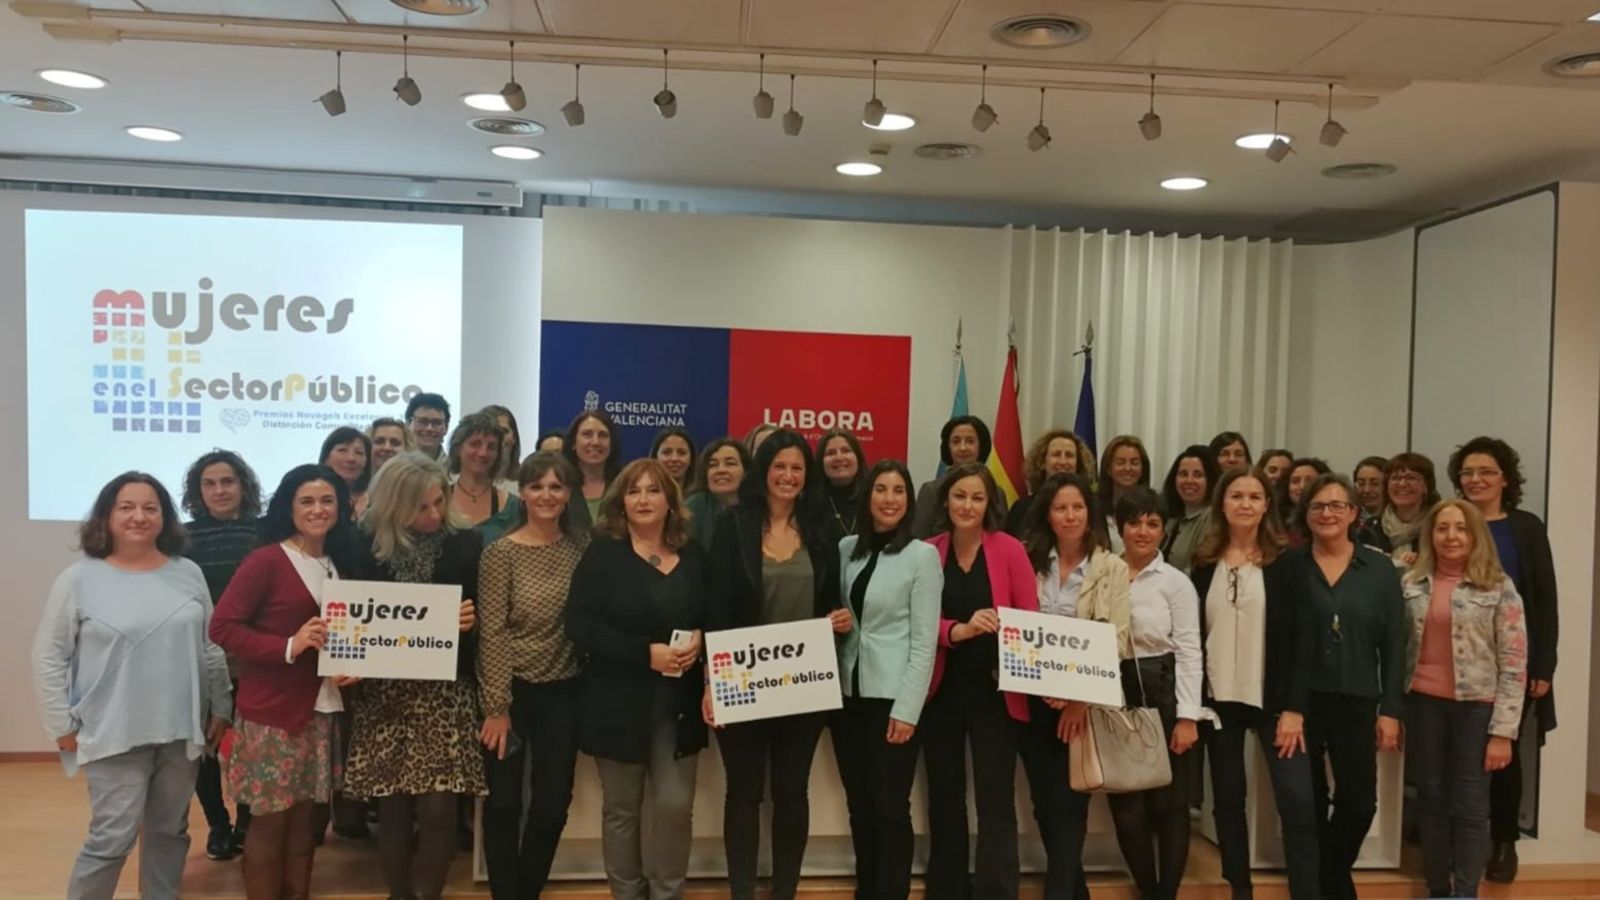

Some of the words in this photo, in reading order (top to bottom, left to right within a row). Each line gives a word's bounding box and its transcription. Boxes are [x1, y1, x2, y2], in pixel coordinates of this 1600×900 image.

[93, 276, 354, 345] mujeres
[252, 409, 294, 419] Premios
[297, 410, 341, 421] Novagob
[604, 401, 688, 415] GENERALITAT
[763, 408, 875, 431] LABORA
[262, 419, 312, 430] Distinción
[326, 597, 429, 624] mujeres
[1003, 626, 1090, 651] mujeres
[712, 642, 805, 669] mujeres
